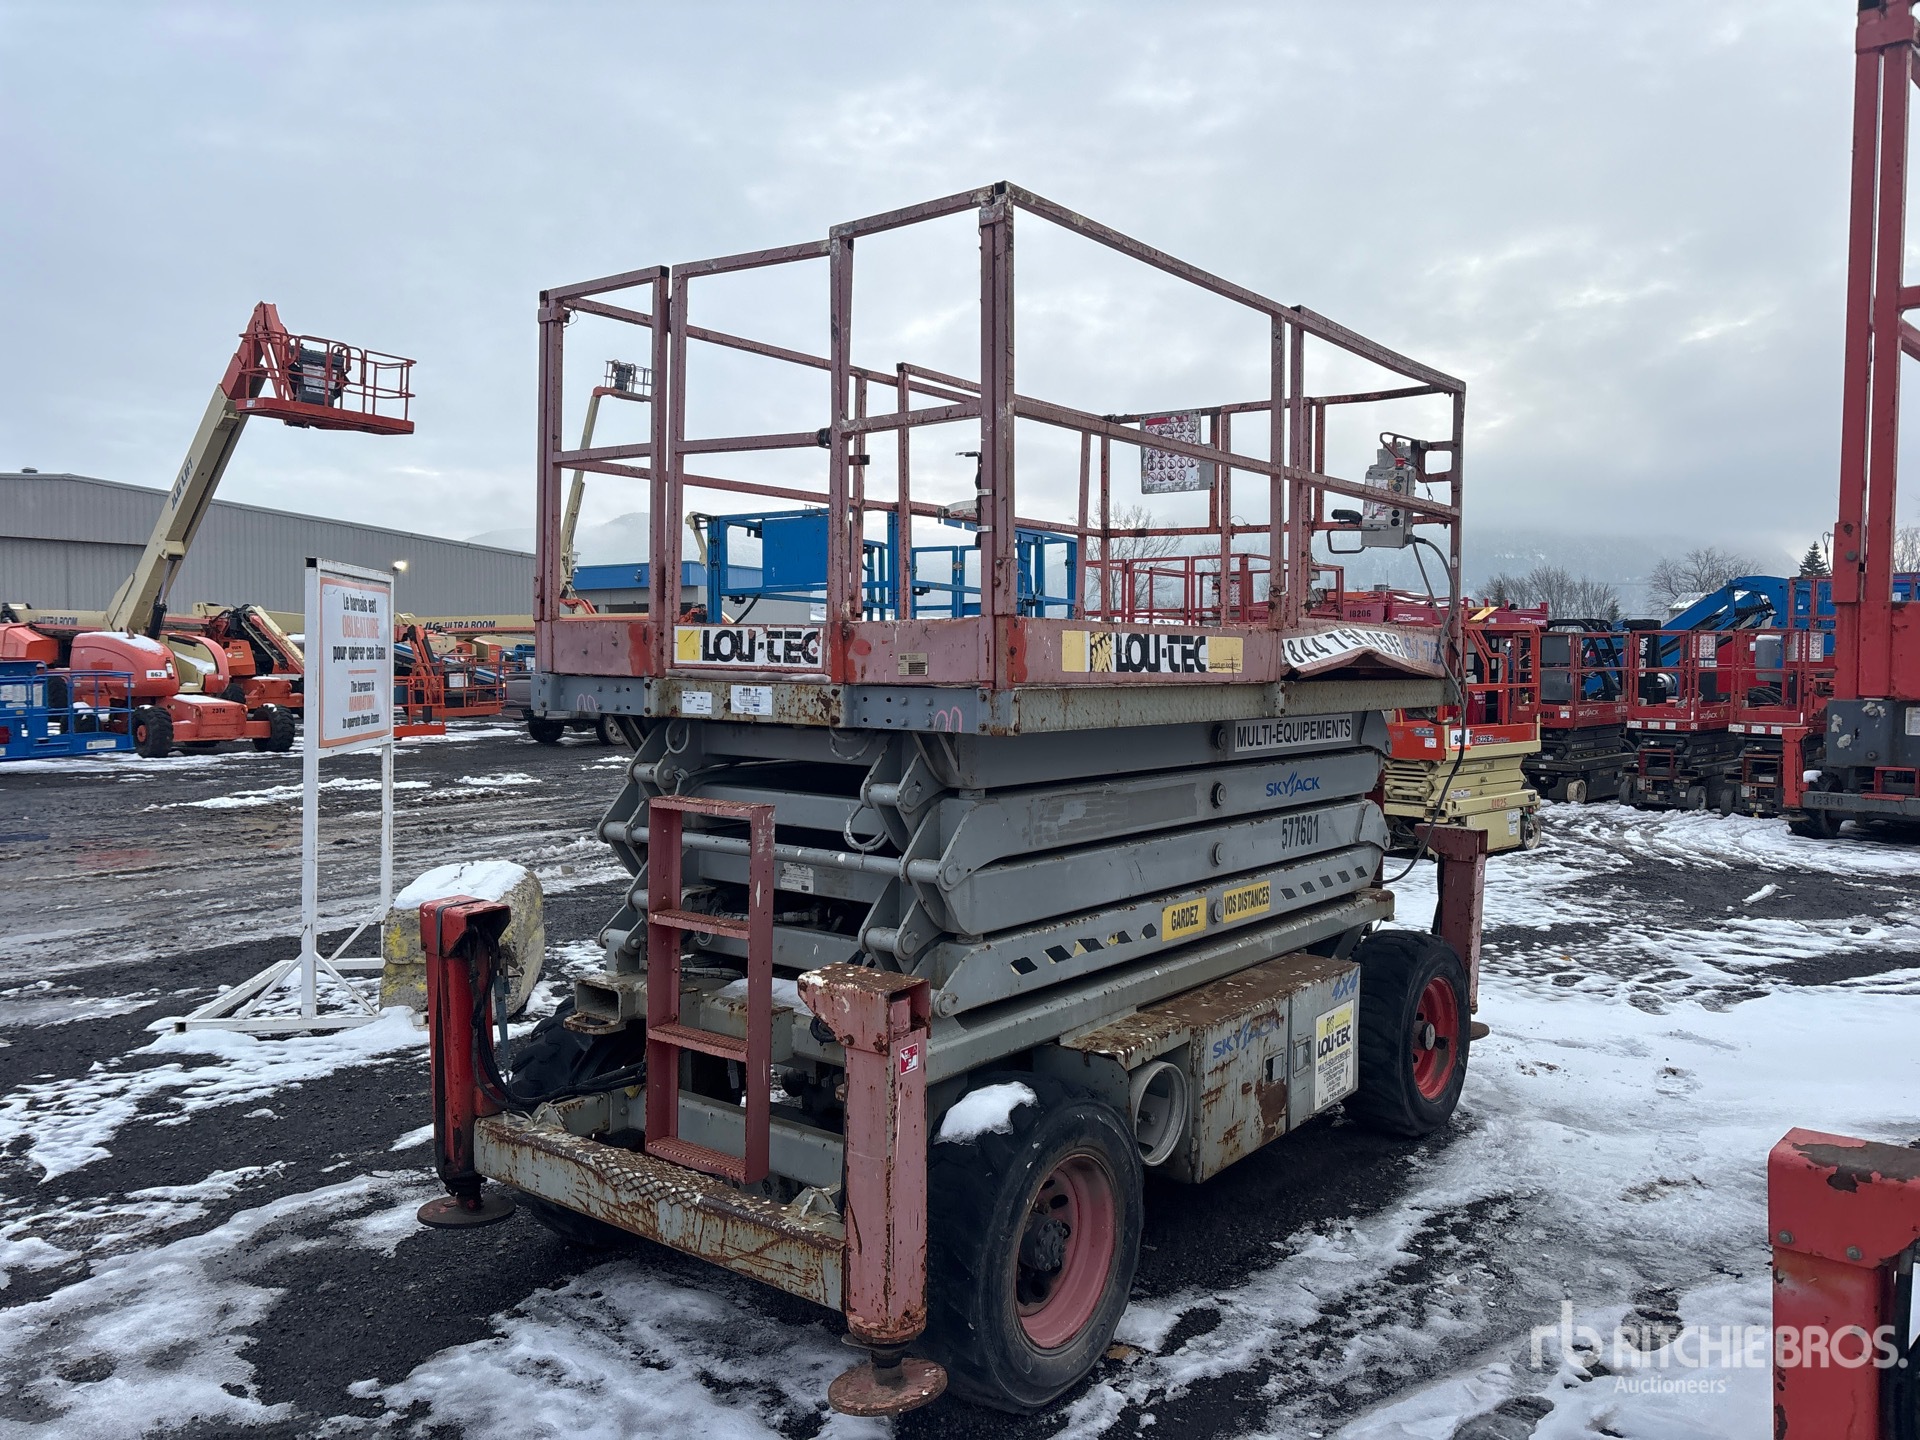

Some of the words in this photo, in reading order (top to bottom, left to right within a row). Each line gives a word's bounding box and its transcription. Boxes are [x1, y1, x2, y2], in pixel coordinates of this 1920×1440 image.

[171, 482, 182, 511] JLG
[181, 456, 193, 487] LIFT
[343, 592, 350, 611] Le
[349, 594, 368, 613] harnais
[368, 598, 378, 614] est
[342, 614, 380, 639] OBLIGATOIRE
[444, 621, 469, 629] ULTRA
[470, 620, 496, 629] BOOM
[333, 645, 347, 663] pour
[348, 642, 365, 663] opérer
[366, 646, 374, 660] ces
[702, 629, 819, 664] LOU-TEC
[1116, 633, 1206, 673] LOU-TEC
[1287, 637, 1333, 664] 844
[1639, 637, 1648, 656] Yale
[348, 694, 375, 712] MANDATORY
[1237, 719, 1351, 748] MULTI-ÉQUIPEMENTS
[1266, 771, 1320, 798] SKYJACK
[1282, 814, 1319, 849] 577601
[1171, 904, 1199, 932] GARDEZ
[1224, 894, 1237, 916] VOS
[1237, 886, 1270, 913] DISTANCES
[1331, 968, 1359, 1001] 4X4
[1213, 1017, 1281, 1061] SKYJACK
[1317, 1024, 1351, 1060] LOU-TEC
